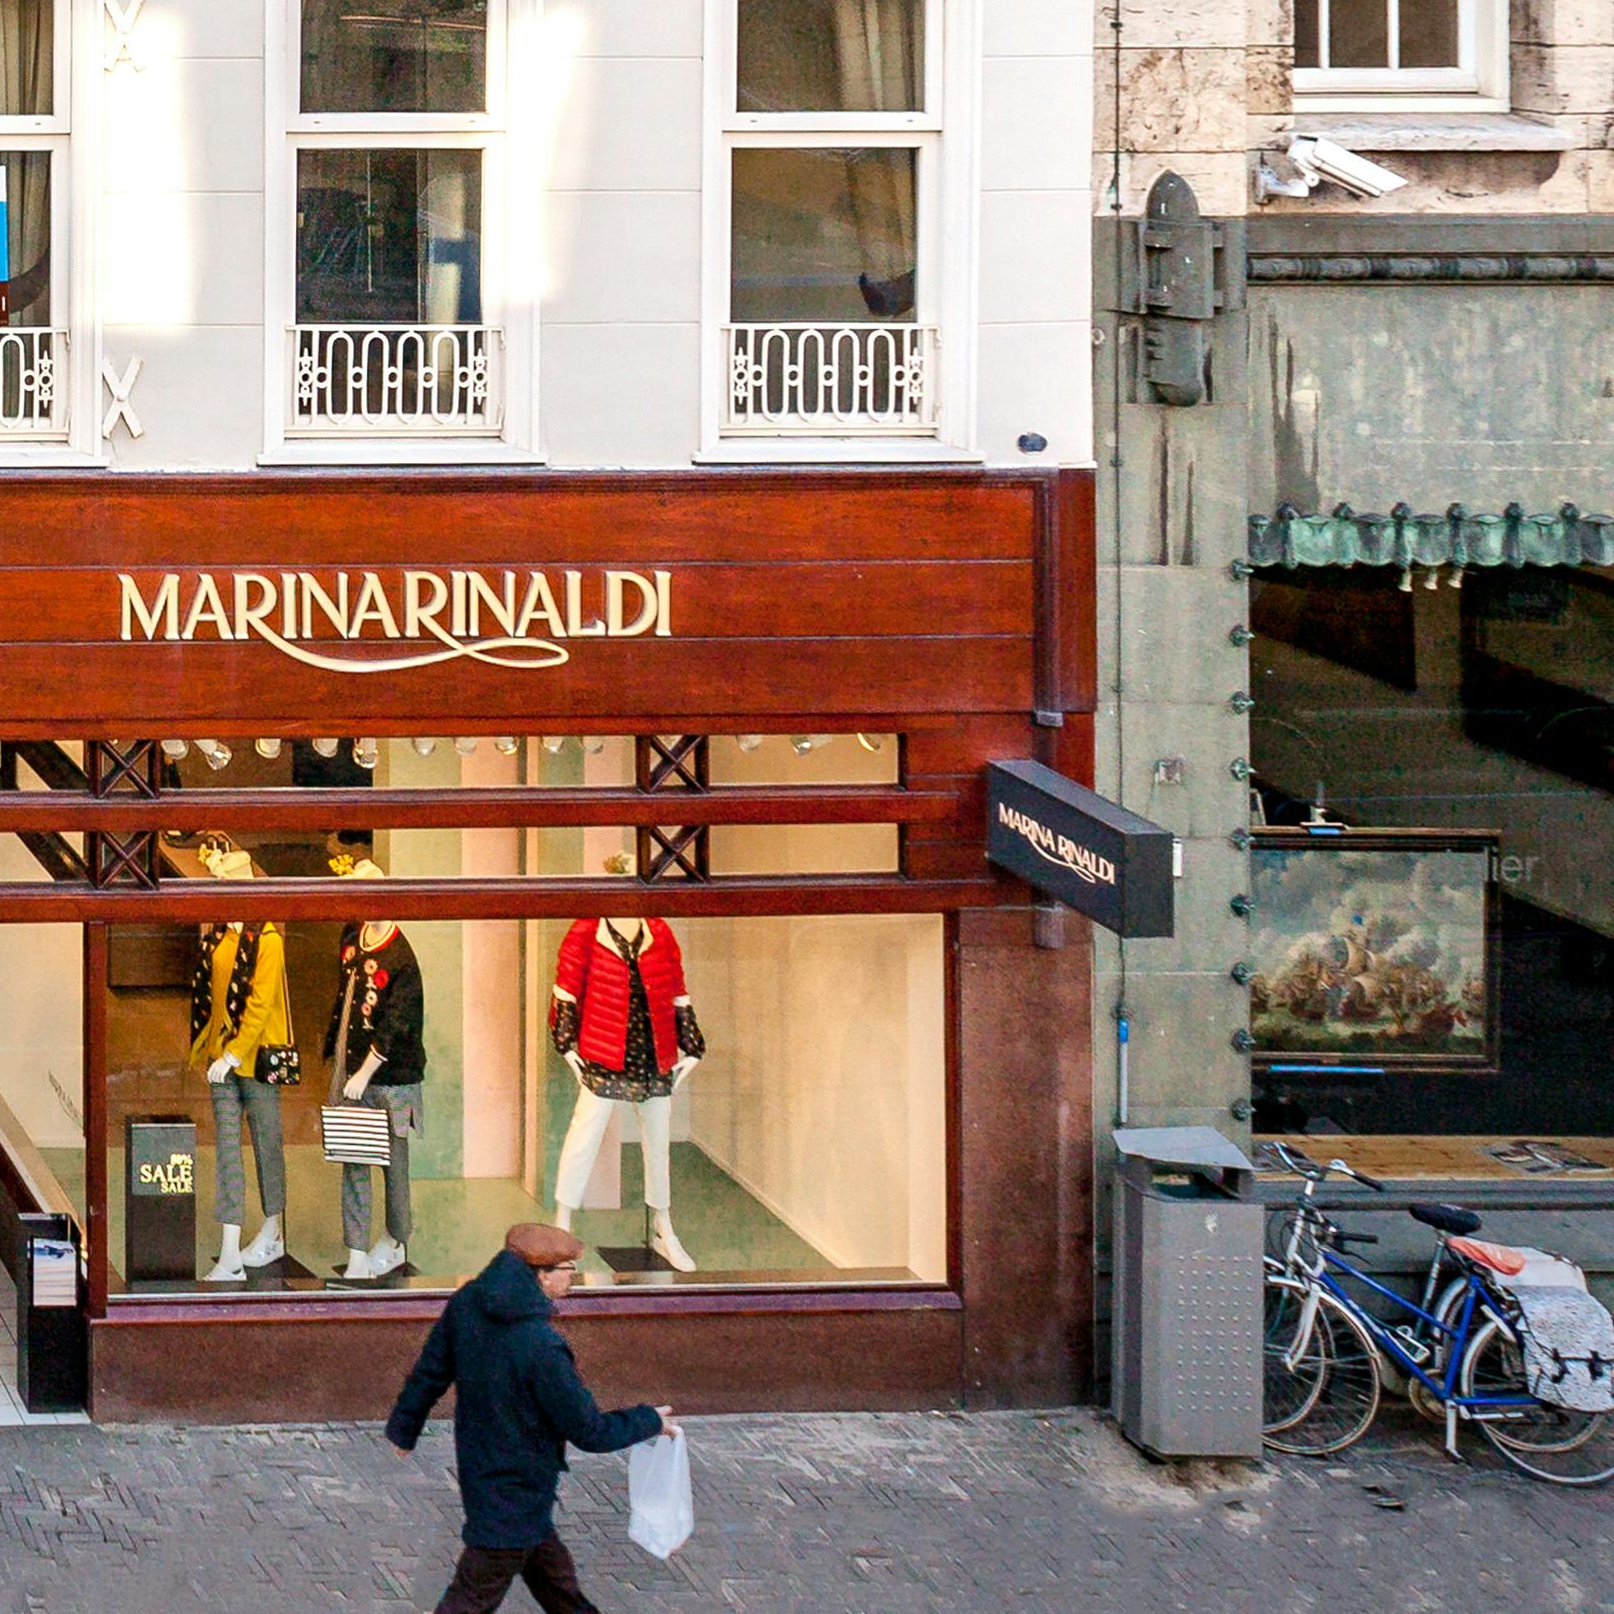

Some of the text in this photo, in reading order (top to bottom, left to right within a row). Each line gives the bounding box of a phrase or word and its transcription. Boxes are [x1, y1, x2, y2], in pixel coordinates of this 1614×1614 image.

[998, 801, 1116, 885] MARINA RINALDI
[140, 1164, 194, 1183] SALE
[161, 1182, 194, 1194] SALE
